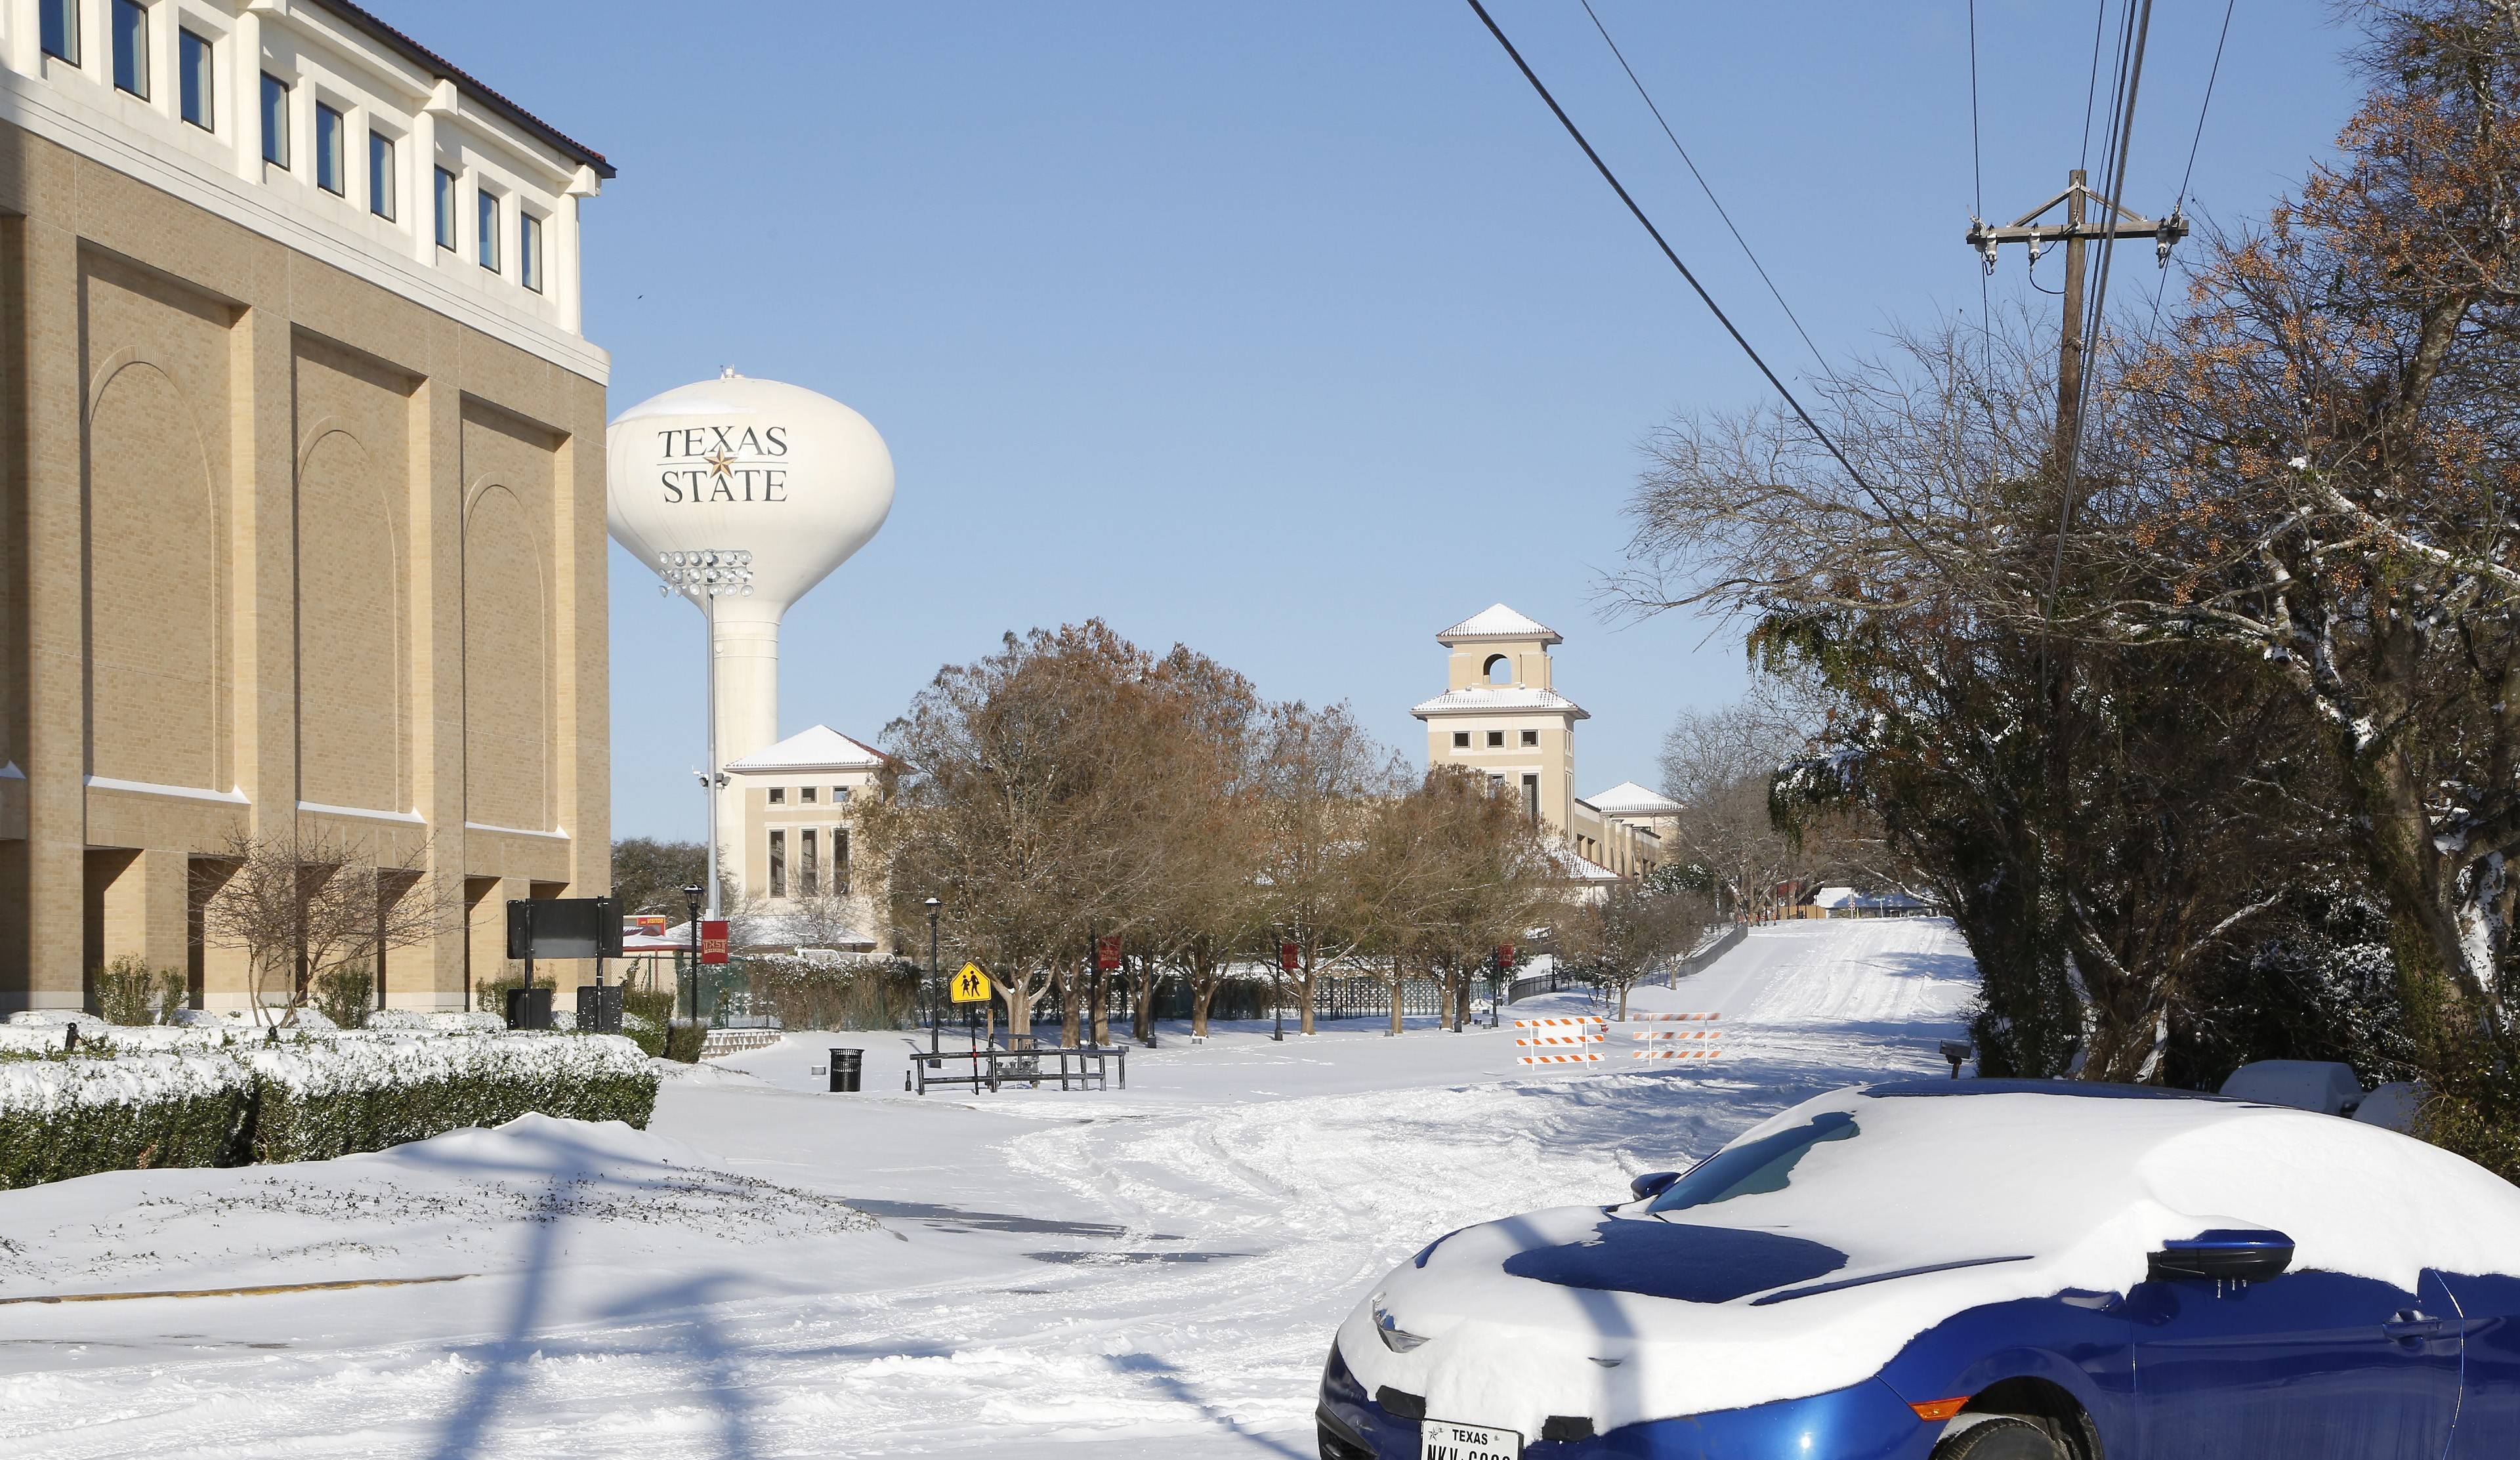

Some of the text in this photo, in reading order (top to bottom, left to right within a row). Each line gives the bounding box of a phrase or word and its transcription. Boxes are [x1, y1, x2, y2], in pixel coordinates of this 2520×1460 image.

[658, 425, 788, 457] TEXAS
[662, 469, 788, 503] STATE
[703, 939, 726, 949] TXST
[1452, 1429, 1488, 1446] TEXAS
